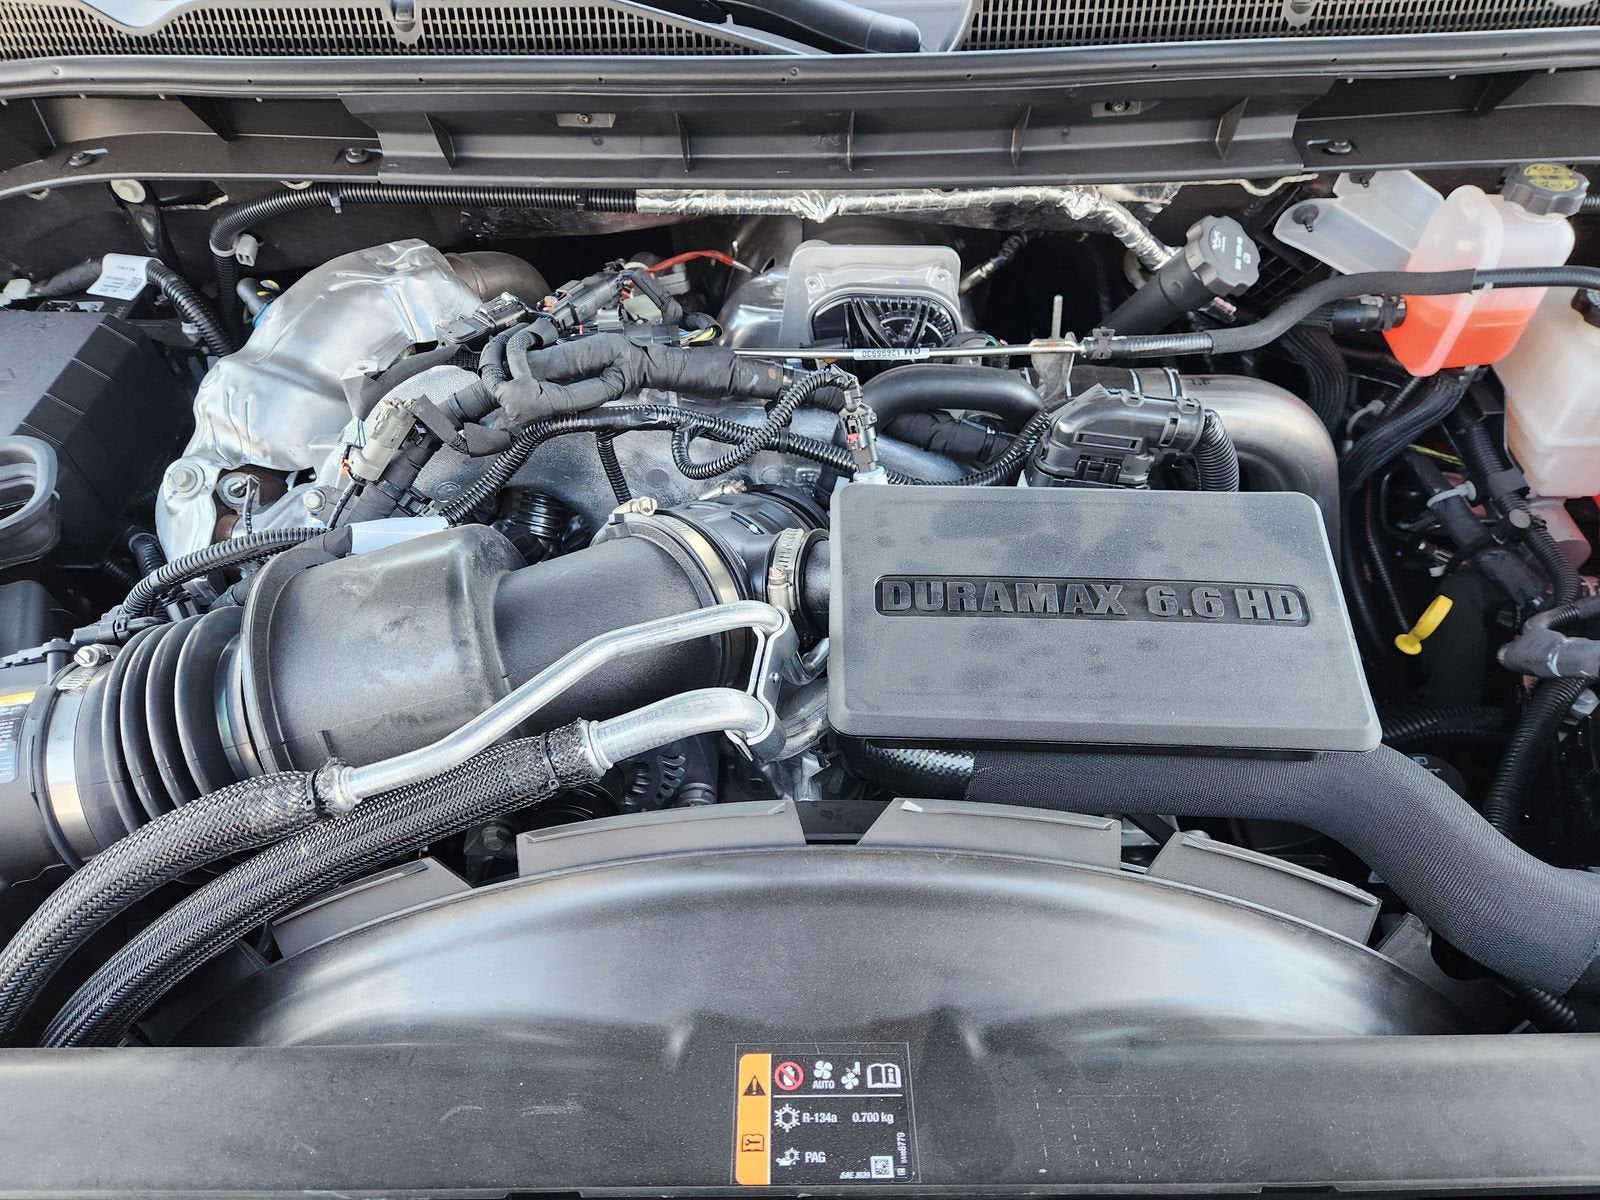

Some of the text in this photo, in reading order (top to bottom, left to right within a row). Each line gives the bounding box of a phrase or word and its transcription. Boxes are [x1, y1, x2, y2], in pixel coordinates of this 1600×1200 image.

[881, 580, 1304, 621] DURAMAX 6.6 HD
[812, 1080, 835, 1090] AUTO
[802, 1111, 894, 1125] R-134a 0.700 kg
[804, 1151, 827, 1163] PAG
